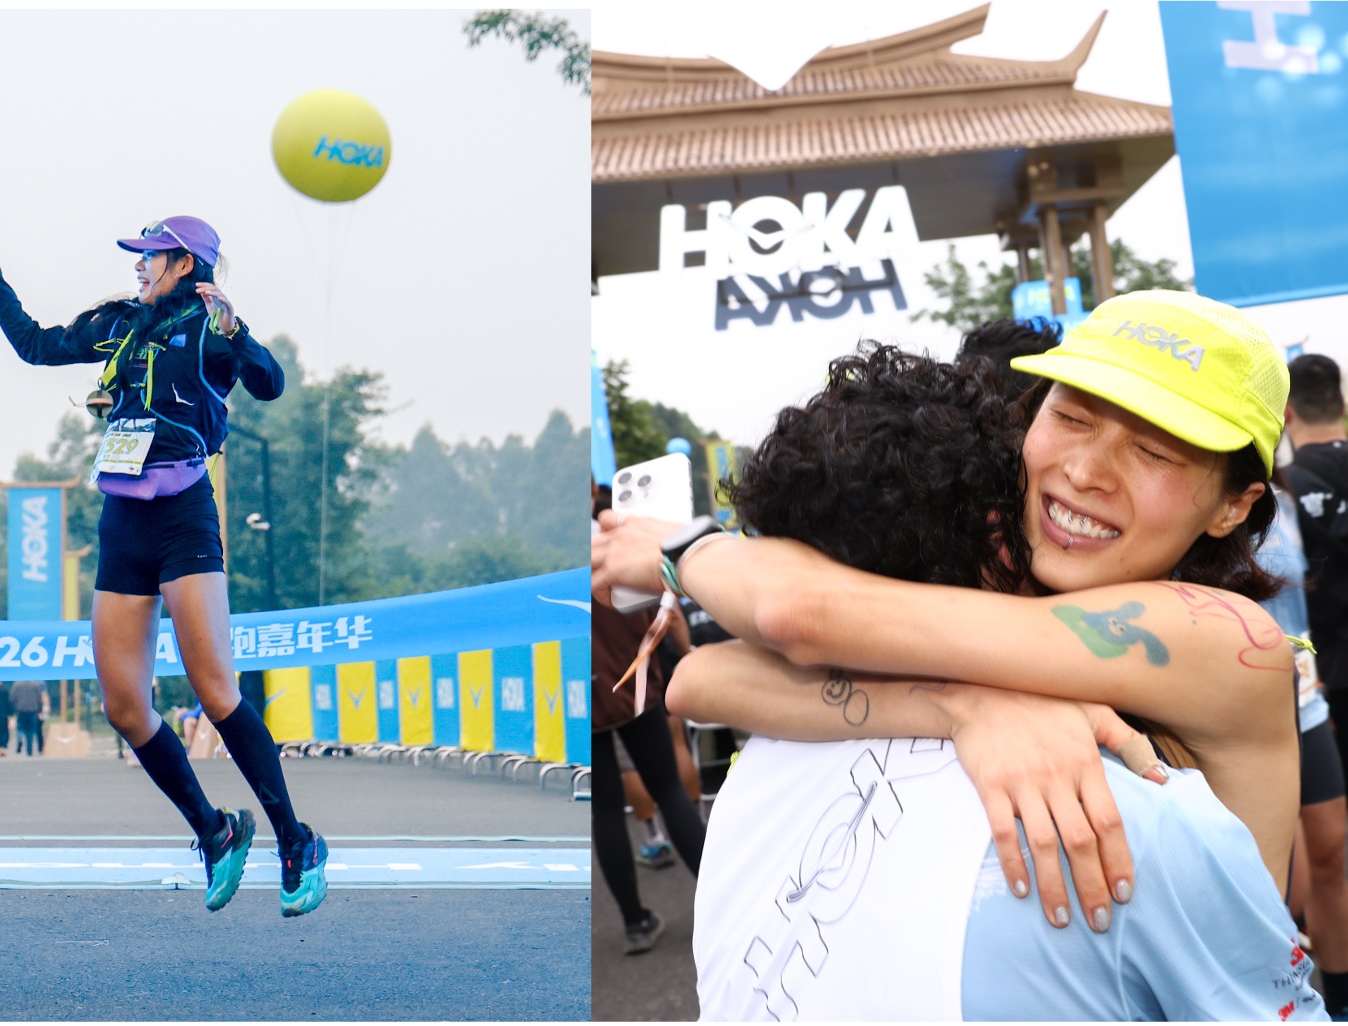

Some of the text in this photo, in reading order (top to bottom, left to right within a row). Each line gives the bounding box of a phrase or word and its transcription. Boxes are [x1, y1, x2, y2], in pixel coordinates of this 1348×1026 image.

[312, 135, 385, 169] HOKA
[659, 185, 920, 281] HOKA
[1112, 320, 1205, 372] HOKA
[21, 495, 49, 583] HOKA
[52, 633, 178, 667] HA
[230, 615, 373, 659] 跑嘉年华
